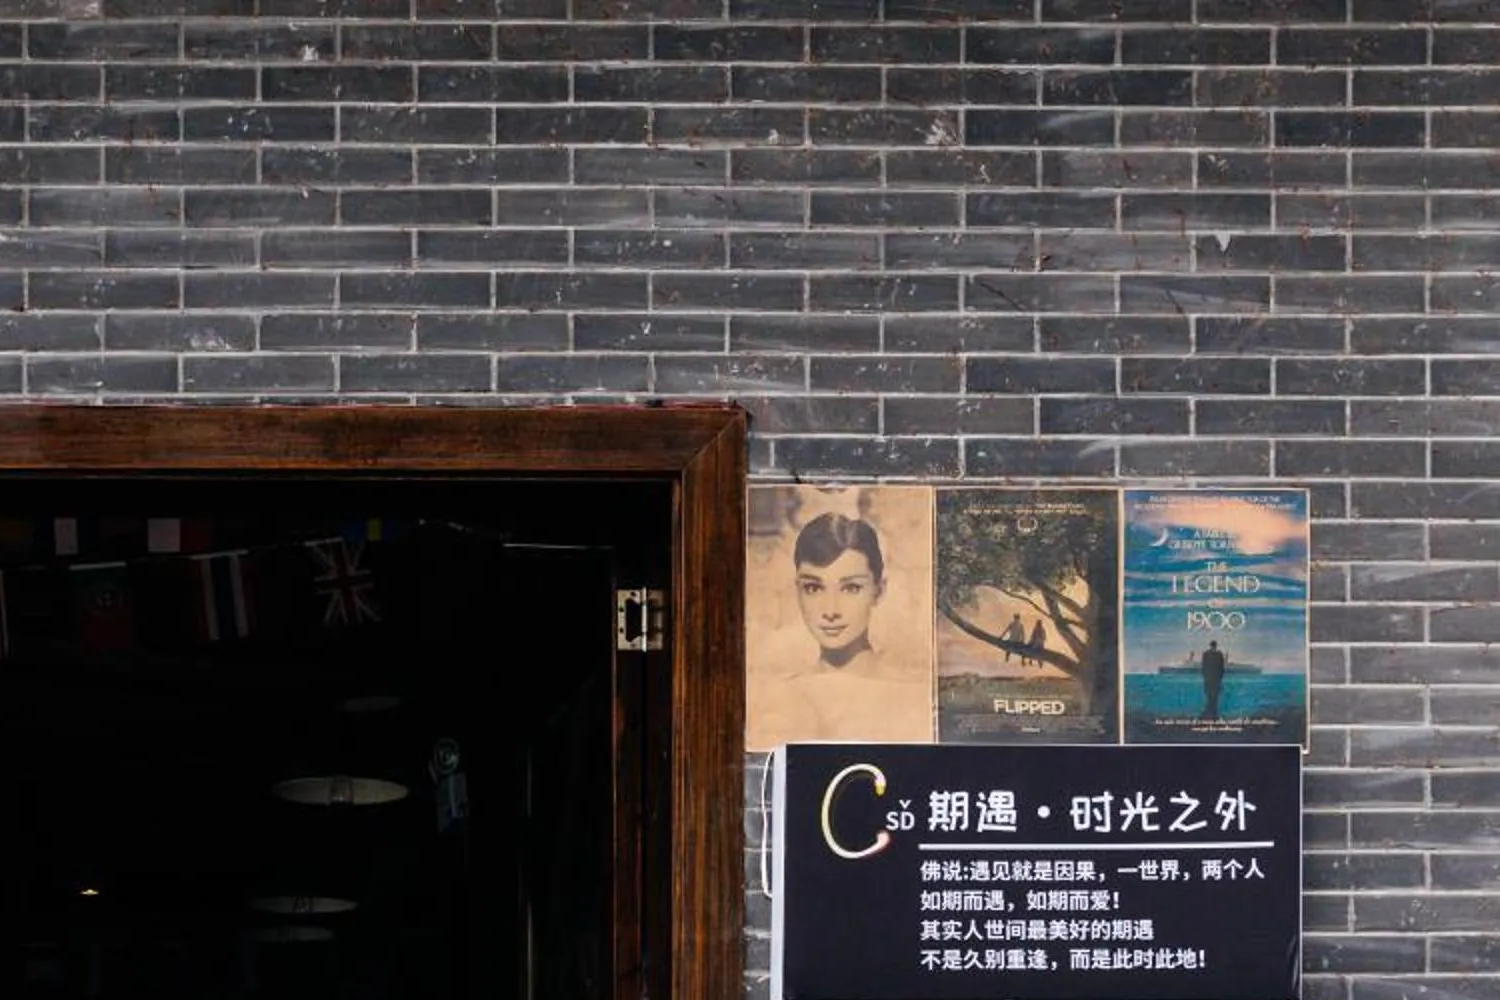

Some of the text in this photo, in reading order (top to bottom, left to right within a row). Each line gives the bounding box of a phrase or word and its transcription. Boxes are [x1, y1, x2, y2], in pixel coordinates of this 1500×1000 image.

[1187, 610, 1246, 630] 1900
[993, 698, 1065, 715] FLIPPED
[920, 919, 1155, 941] 其实人世间最美好的期遇
